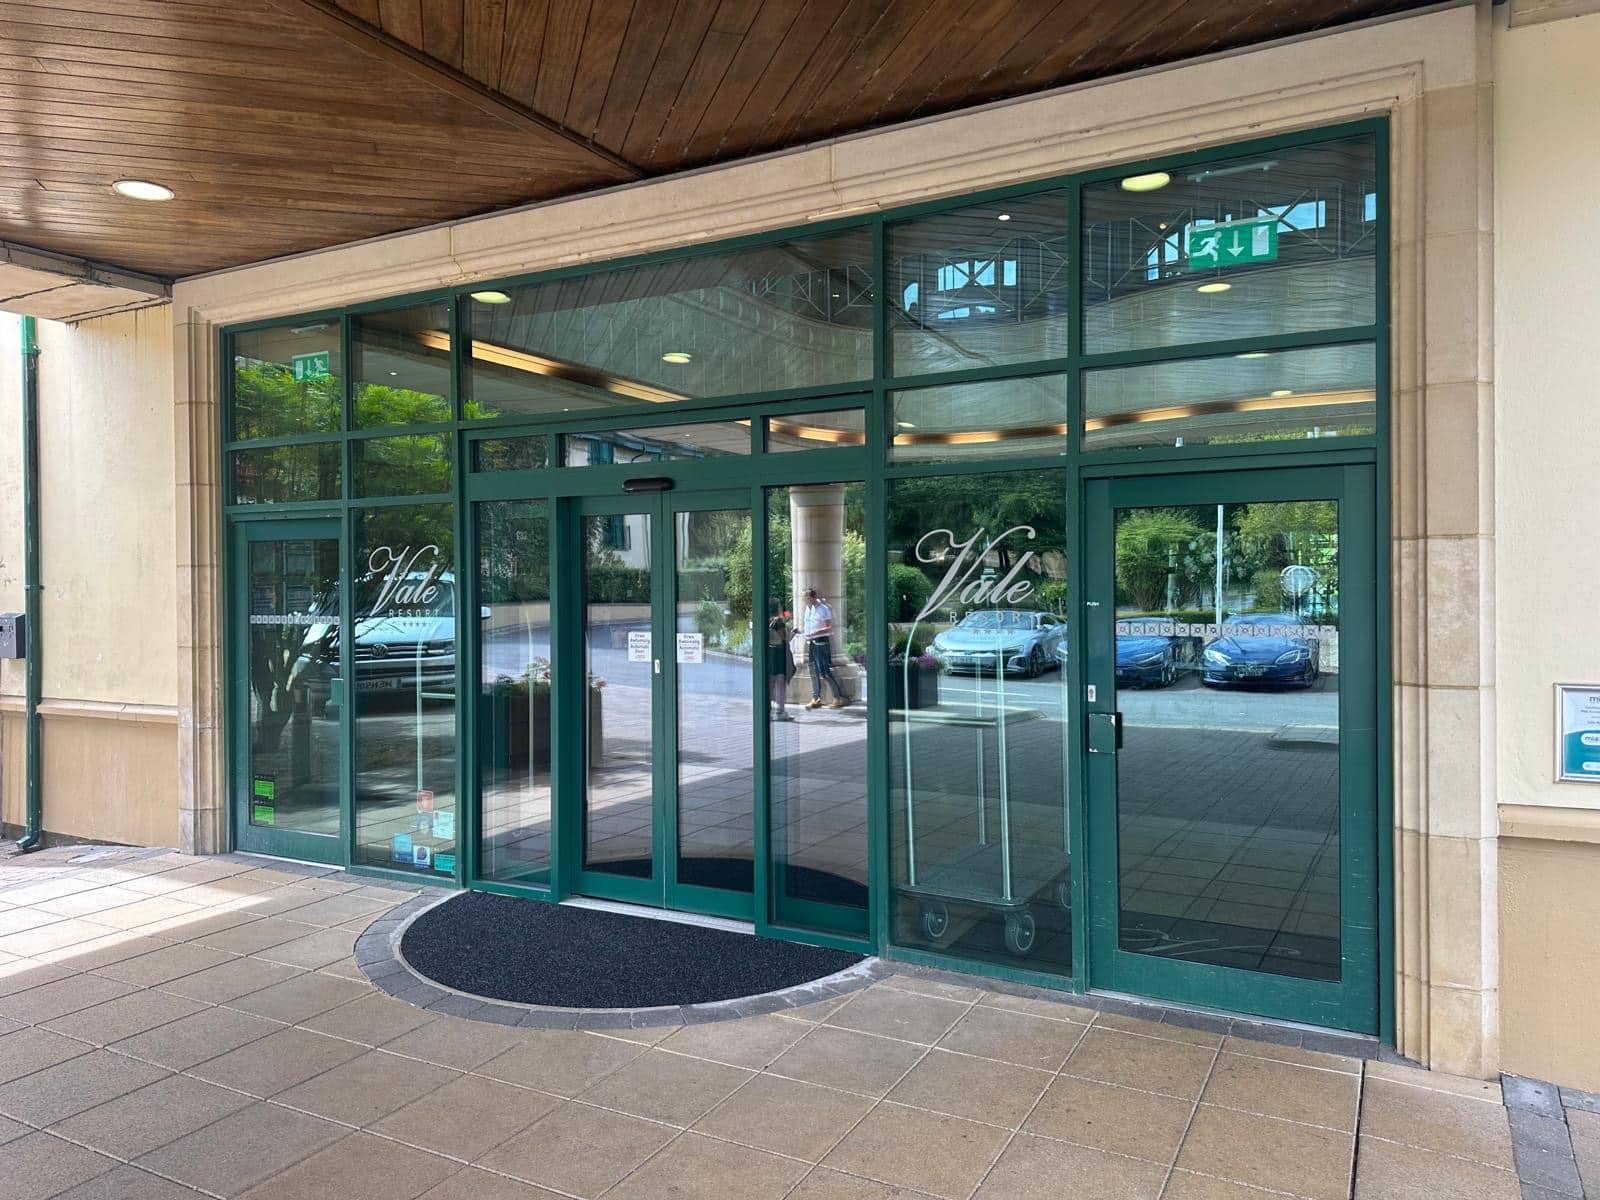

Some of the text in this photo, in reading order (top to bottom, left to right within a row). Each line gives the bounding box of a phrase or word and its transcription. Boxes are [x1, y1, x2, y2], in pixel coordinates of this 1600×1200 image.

[368, 544, 439, 617] Vale
[915, 525, 1036, 621] Vale
[388, 608, 440, 617] RESORT
